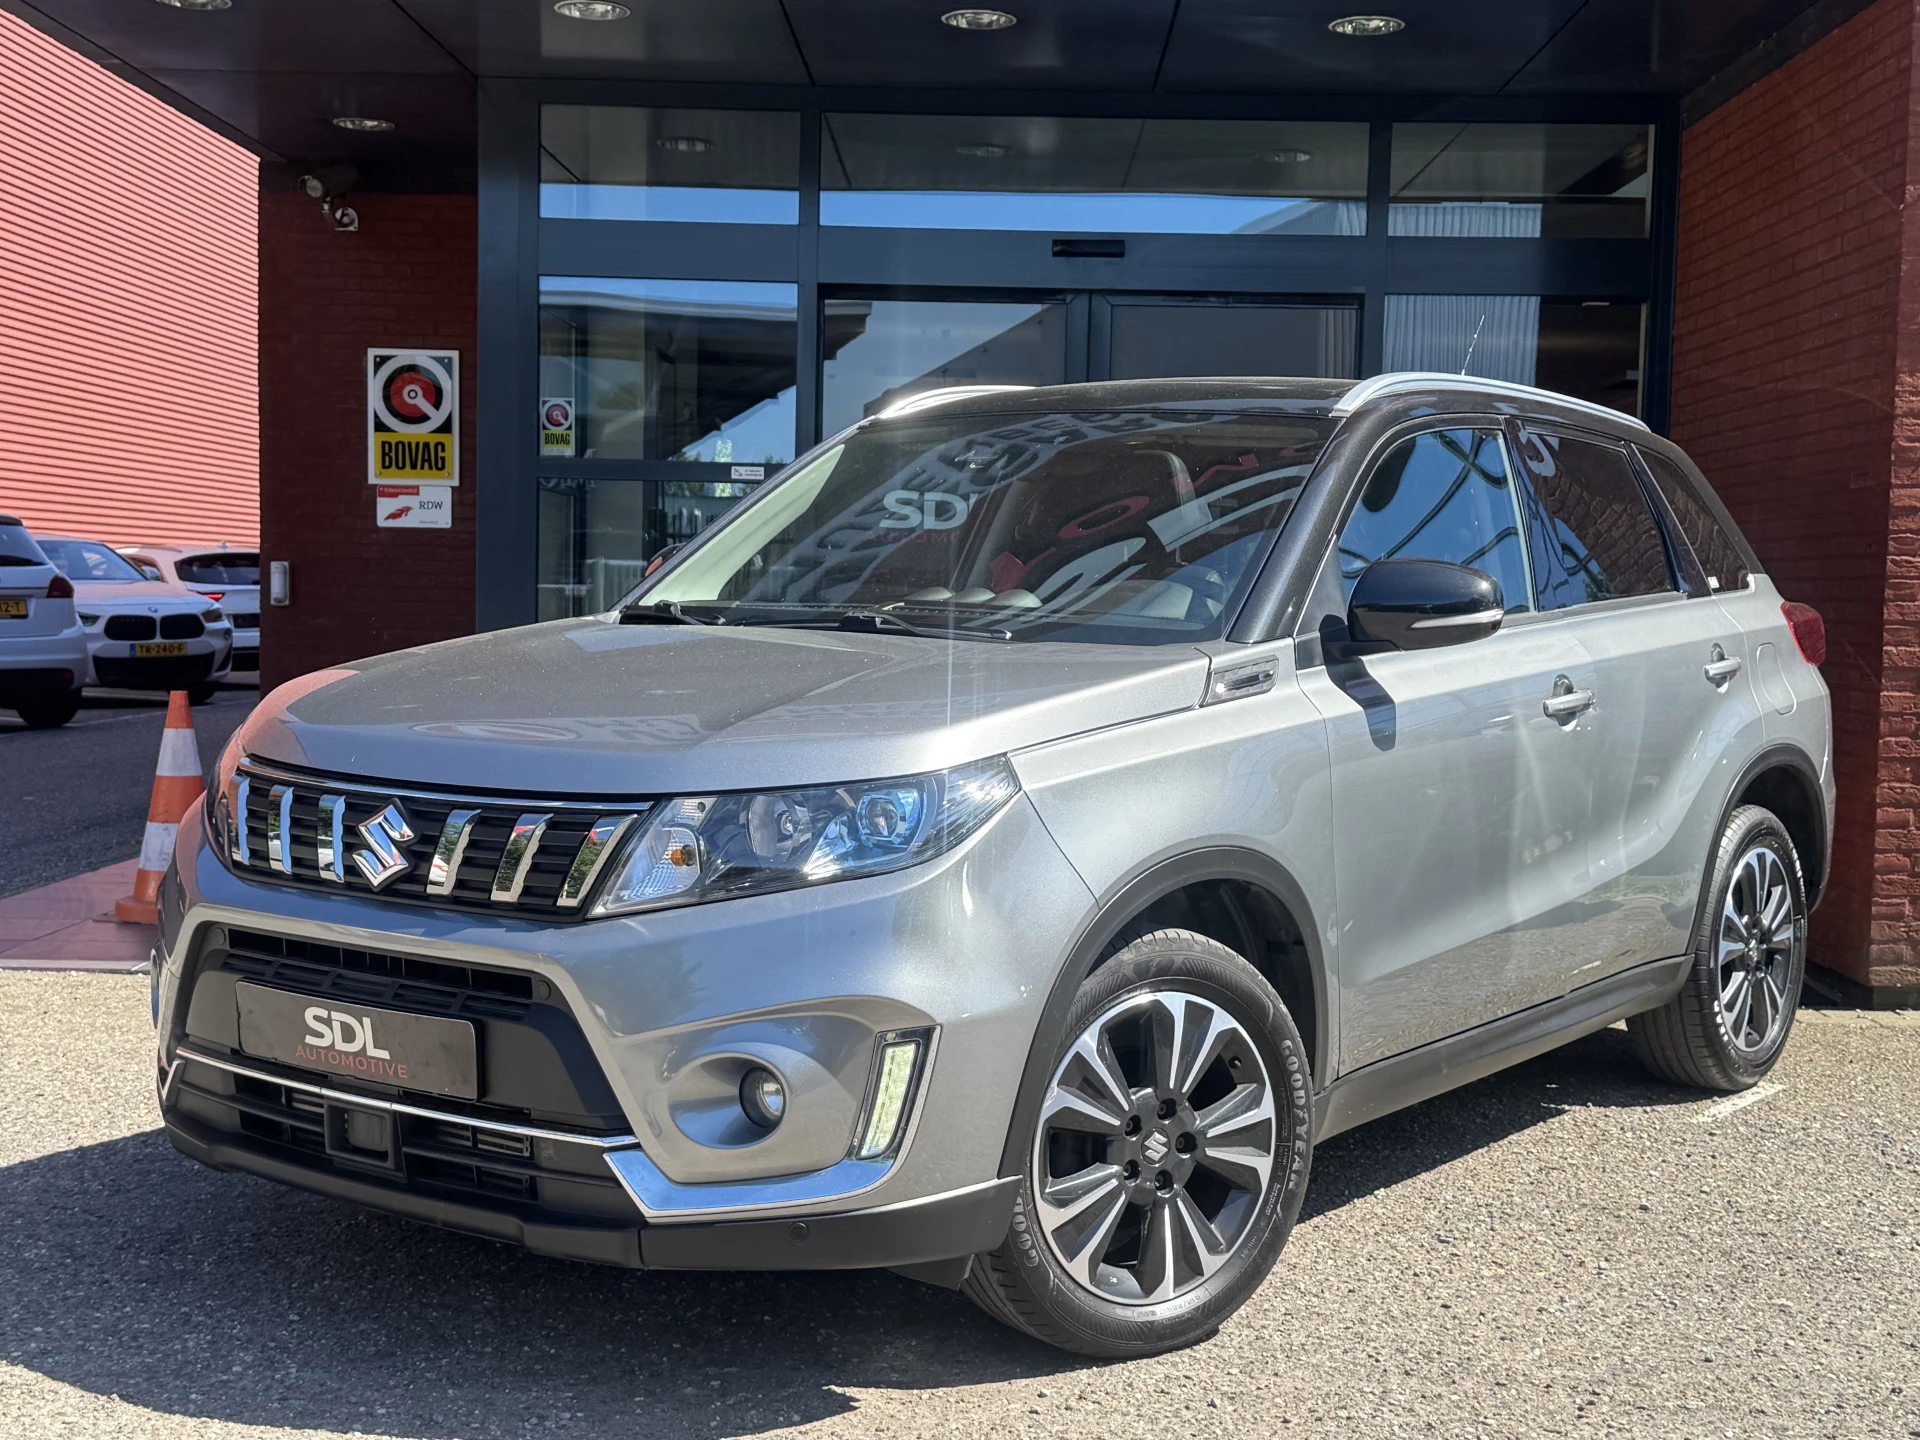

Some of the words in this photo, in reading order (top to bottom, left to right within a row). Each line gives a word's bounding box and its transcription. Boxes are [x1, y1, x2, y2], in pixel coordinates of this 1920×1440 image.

[544, 432, 571, 446] BOVAG
[381, 440, 446, 471] BOVAG
[419, 500, 443, 510] RDW
[304, 1006, 391, 1060] SDL
[296, 1045, 408, 1079] AUTOMOTIVE
